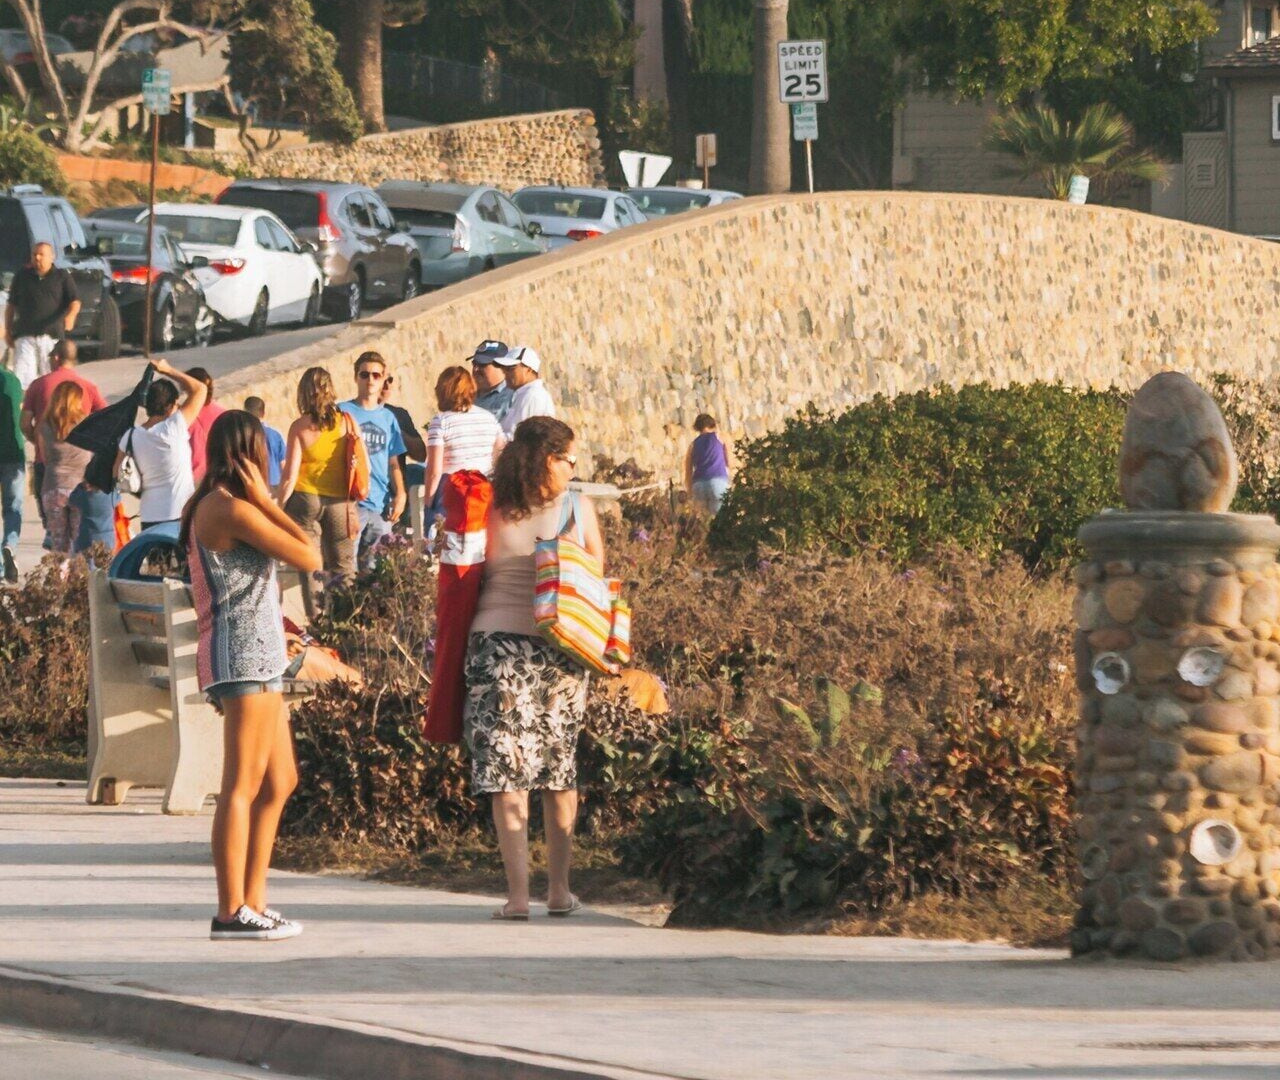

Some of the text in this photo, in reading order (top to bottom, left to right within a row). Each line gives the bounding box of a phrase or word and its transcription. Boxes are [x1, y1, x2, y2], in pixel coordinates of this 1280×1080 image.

[781, 46, 822, 56] SPEED
[785, 60, 819, 70] LIMIT
[785, 74, 821, 97] 25
